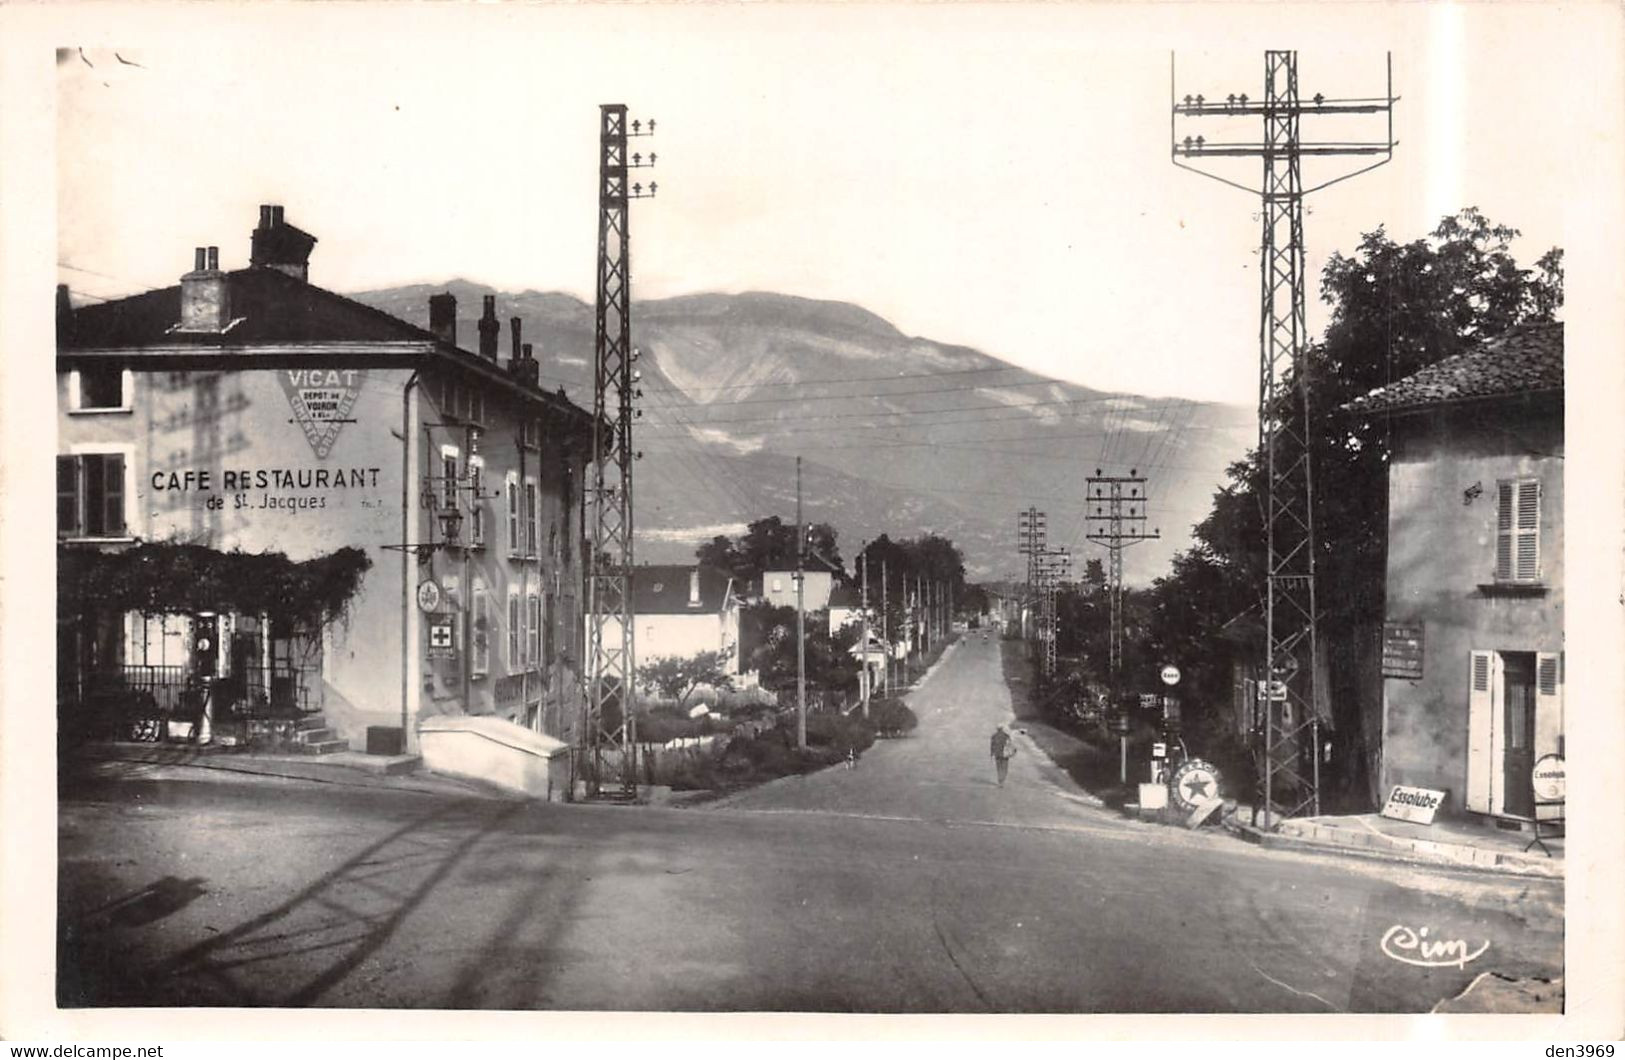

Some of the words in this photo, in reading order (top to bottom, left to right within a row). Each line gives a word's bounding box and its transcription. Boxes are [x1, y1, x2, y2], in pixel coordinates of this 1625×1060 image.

[287, 369, 359, 387] VICAT
[151, 471, 210, 491] CAFE
[224, 468, 381, 490] RESTAURANT
[206, 495, 224, 511] de
[258, 494, 326, 515] Jacques
[1534, 770, 1566, 780] Essolub
[1391, 787, 1438, 809] Essolube
